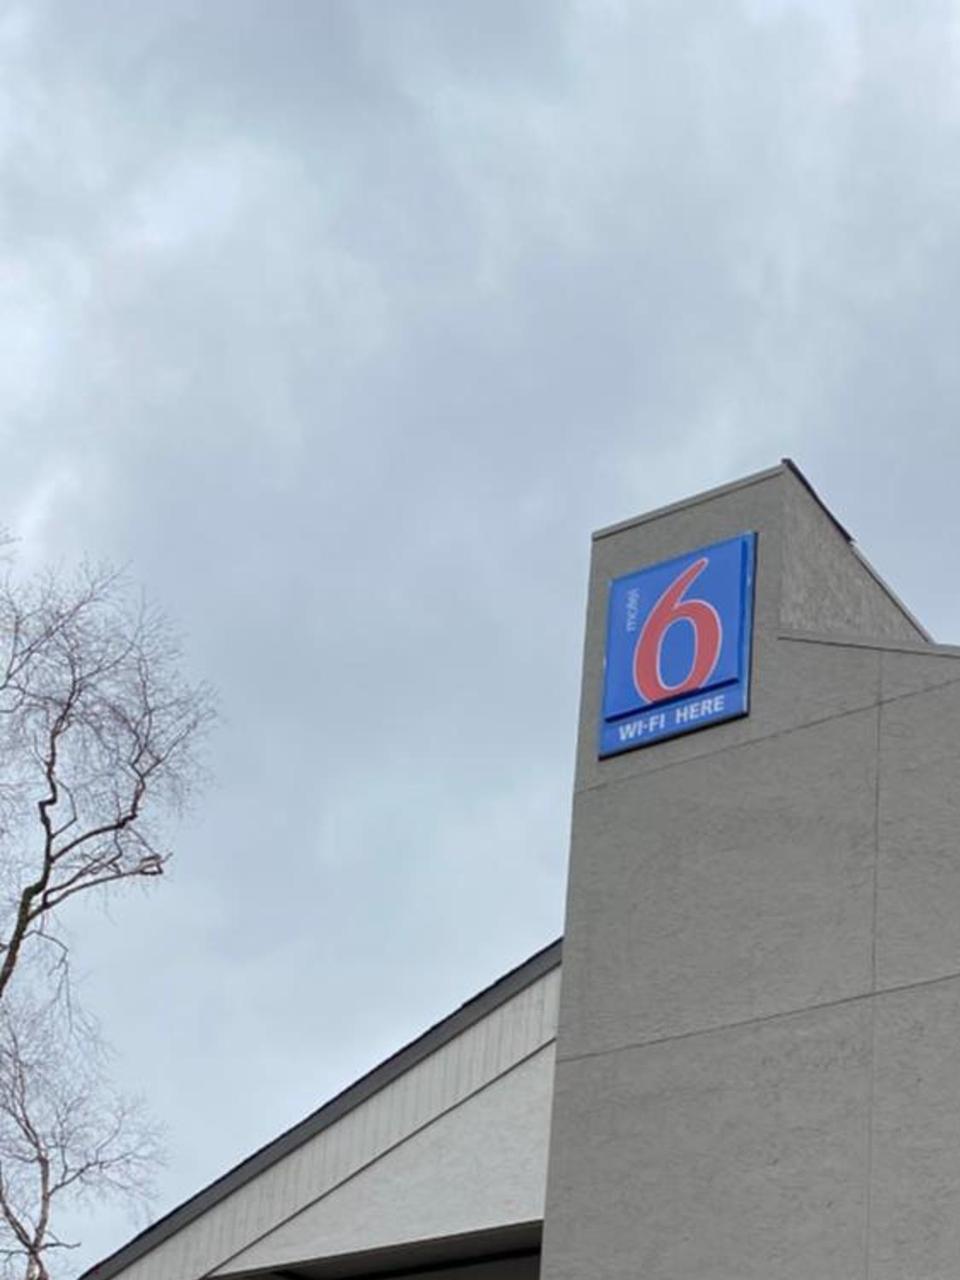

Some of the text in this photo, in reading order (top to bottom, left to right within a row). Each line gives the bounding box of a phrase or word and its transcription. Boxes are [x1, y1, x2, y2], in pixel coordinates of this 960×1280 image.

[633, 557, 722, 704] 6
[619, 695, 725, 741] WI-FI HERE
